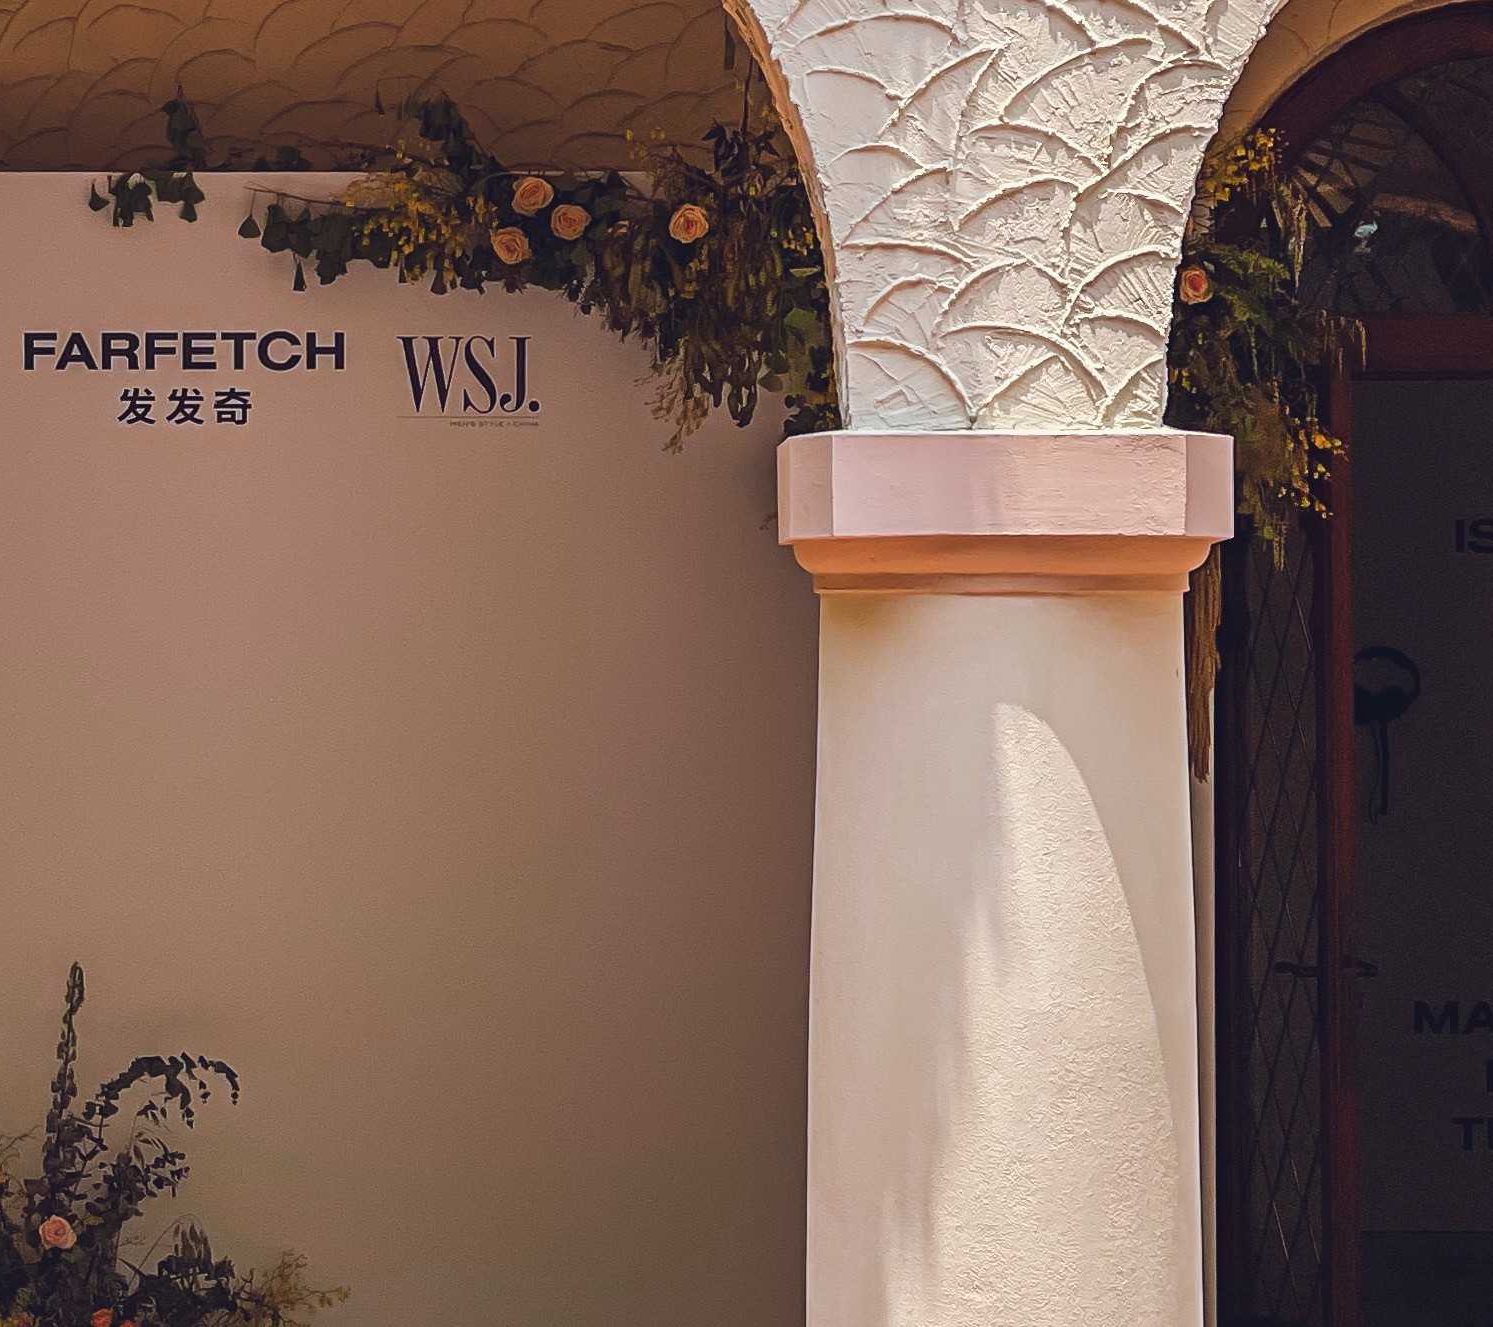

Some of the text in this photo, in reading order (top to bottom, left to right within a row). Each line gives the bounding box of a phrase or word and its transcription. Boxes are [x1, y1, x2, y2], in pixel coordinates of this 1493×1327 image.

[23, 331, 345, 371] FARFETCH
[397, 336, 540, 414] WSJ.
[118, 387, 252, 426] 发发奇
